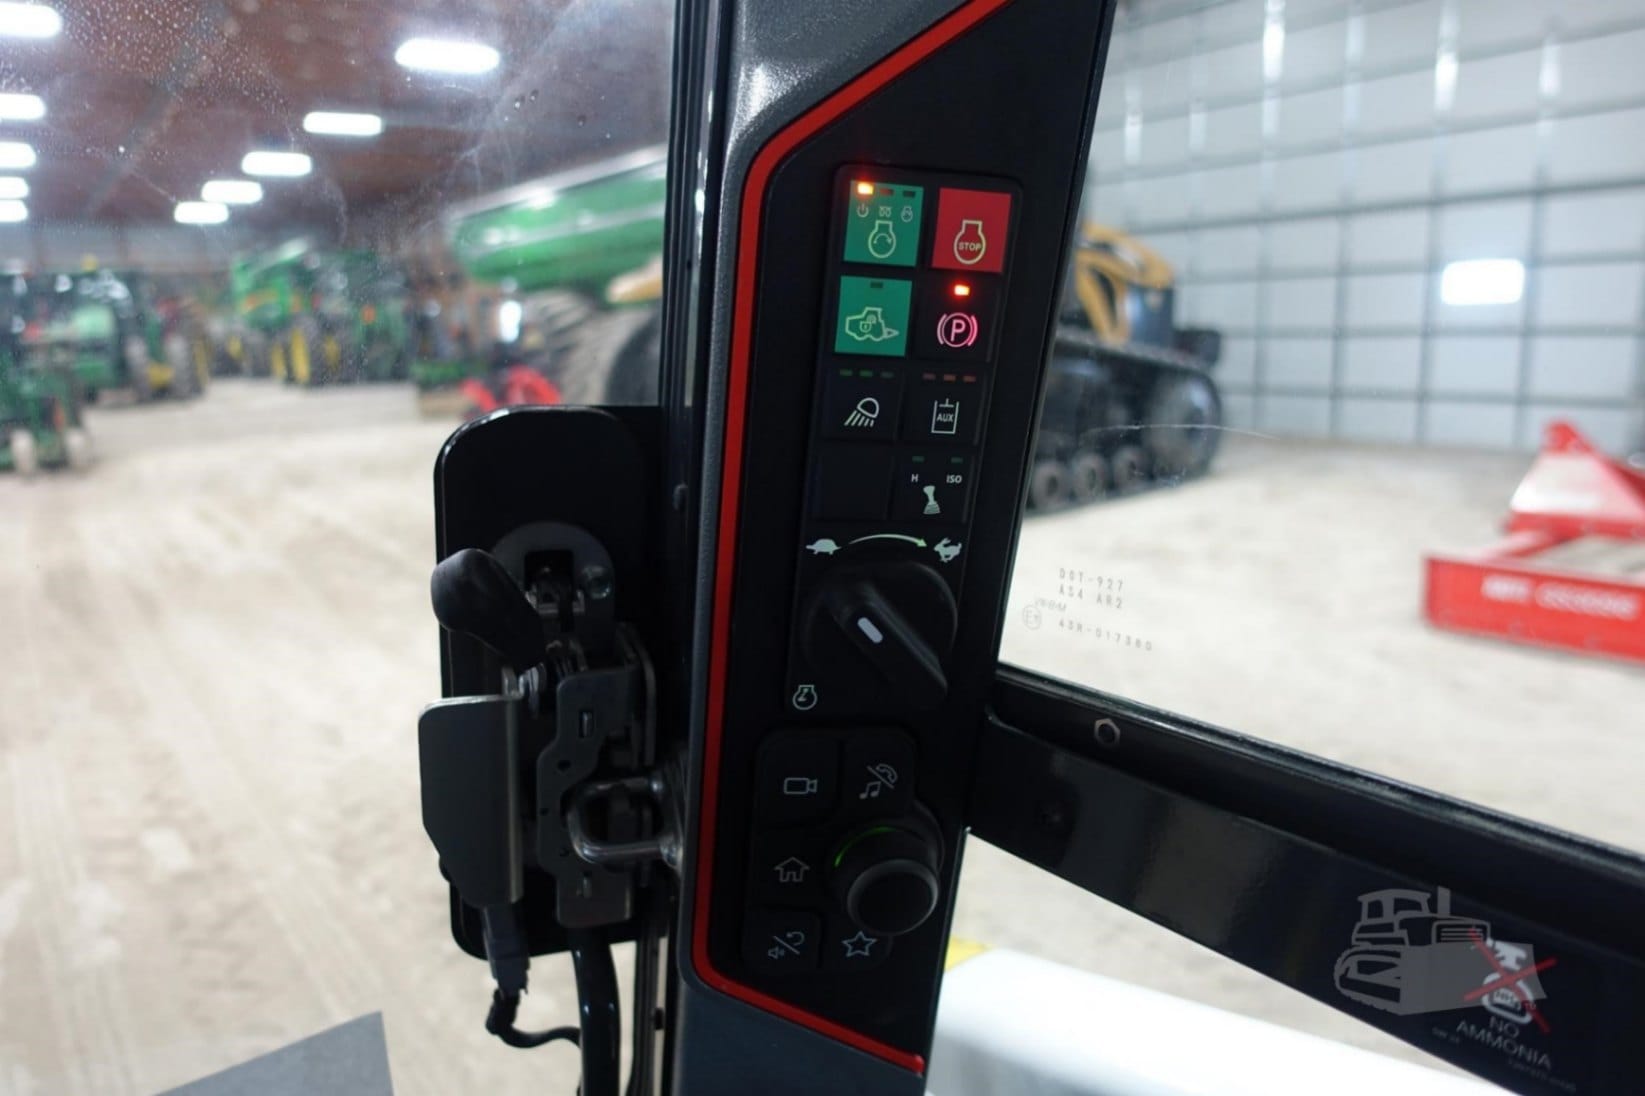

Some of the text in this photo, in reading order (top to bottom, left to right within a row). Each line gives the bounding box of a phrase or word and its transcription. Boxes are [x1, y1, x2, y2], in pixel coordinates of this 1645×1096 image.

[958, 242, 982, 252] STOP
[950, 319, 966, 342] P
[936, 413, 954, 422] AUX
[910, 473, 919, 483] H
[946, 475, 962, 484] ISO
[1490, 1016, 1519, 1038] NO
[1456, 1020, 1552, 1069] AMMONIA
